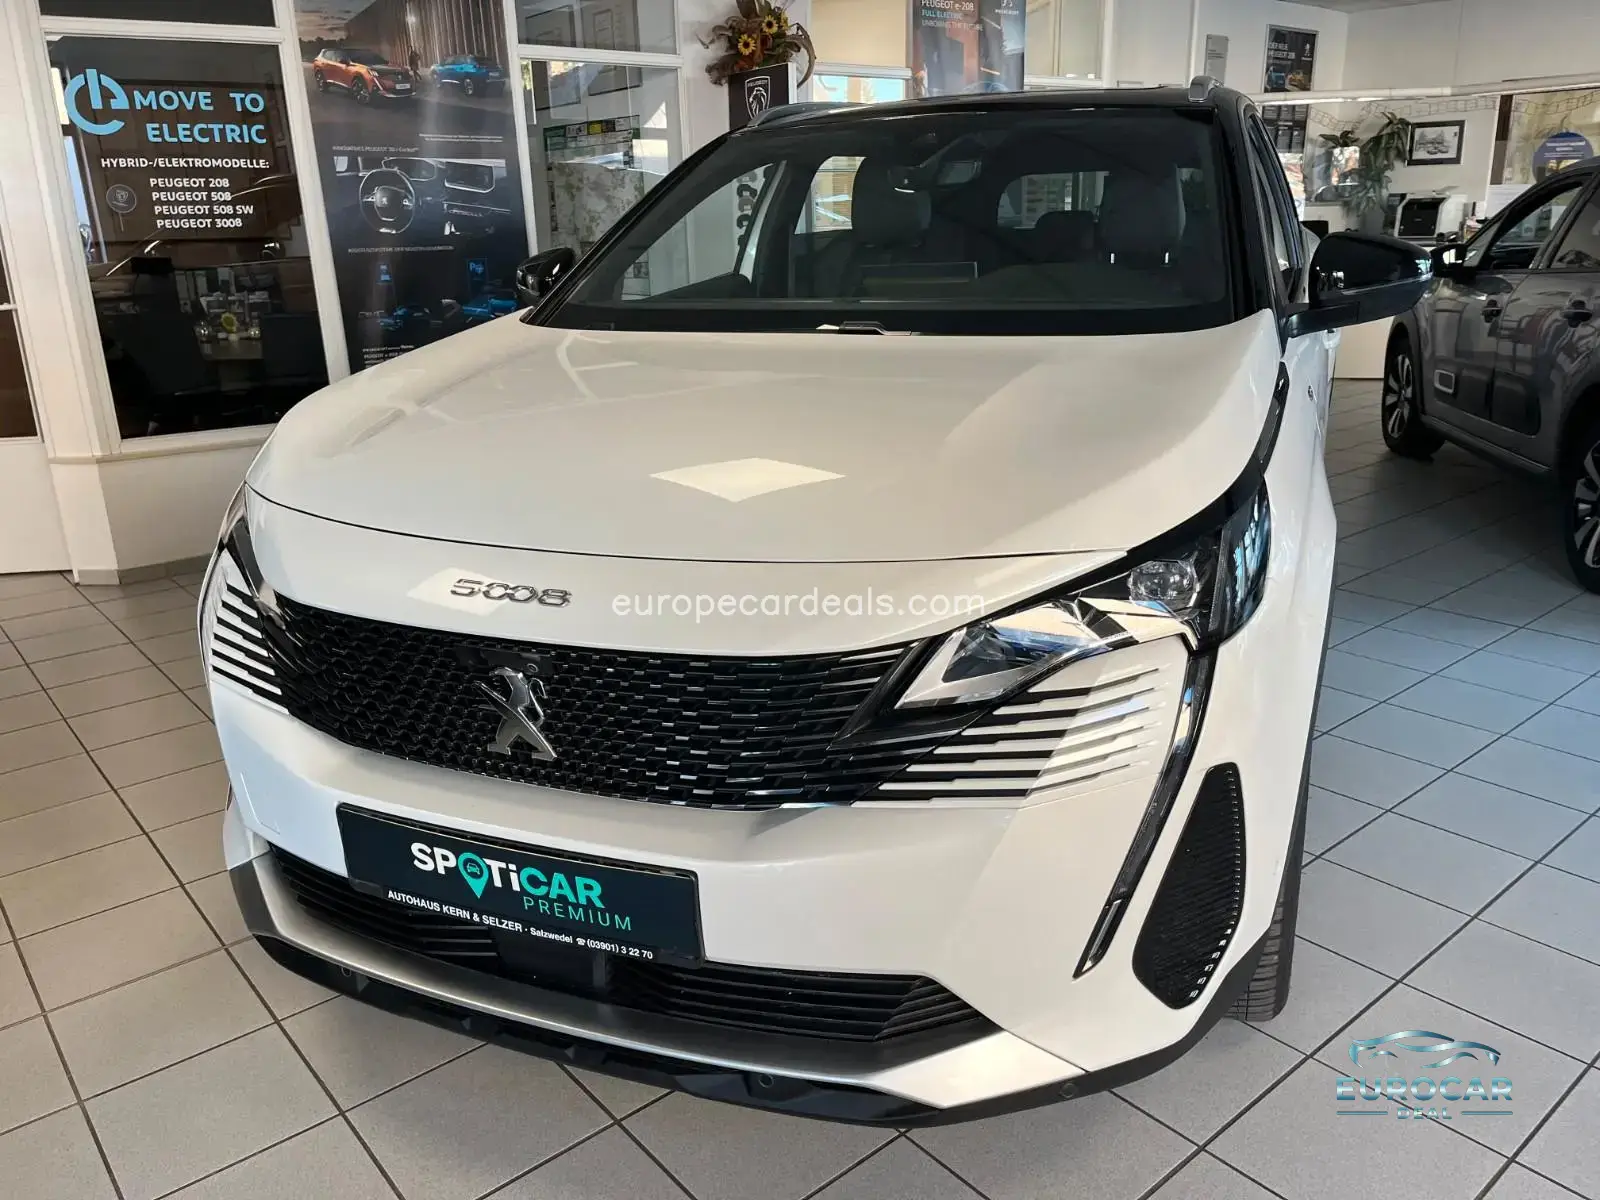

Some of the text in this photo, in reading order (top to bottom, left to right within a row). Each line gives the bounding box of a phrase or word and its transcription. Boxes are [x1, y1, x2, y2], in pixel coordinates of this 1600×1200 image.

[921, 0, 974, 11] PEUGEOT e-208
[922, 9, 936, 17] FULL
[133, 90, 265, 113] MOVE TO
[146, 123, 267, 144] ELECTRIC
[101, 157, 270, 169] HYBRID-/ELEKTROMODELLE:
[150, 178, 230, 188] PEUGEOT 208
[152, 191, 232, 201] PEUGEOT 508
[154, 205, 254, 215] PEUGEOT 508 SW
[156, 218, 243, 229] PEUGEOT 3008
[450, 578, 572, 608] 5008
[523, 896, 632, 931] PREMIUM
[387, 890, 653, 960] AUTOHAUS KERN & SELZER Salzwedel (03901) 3 22 70
